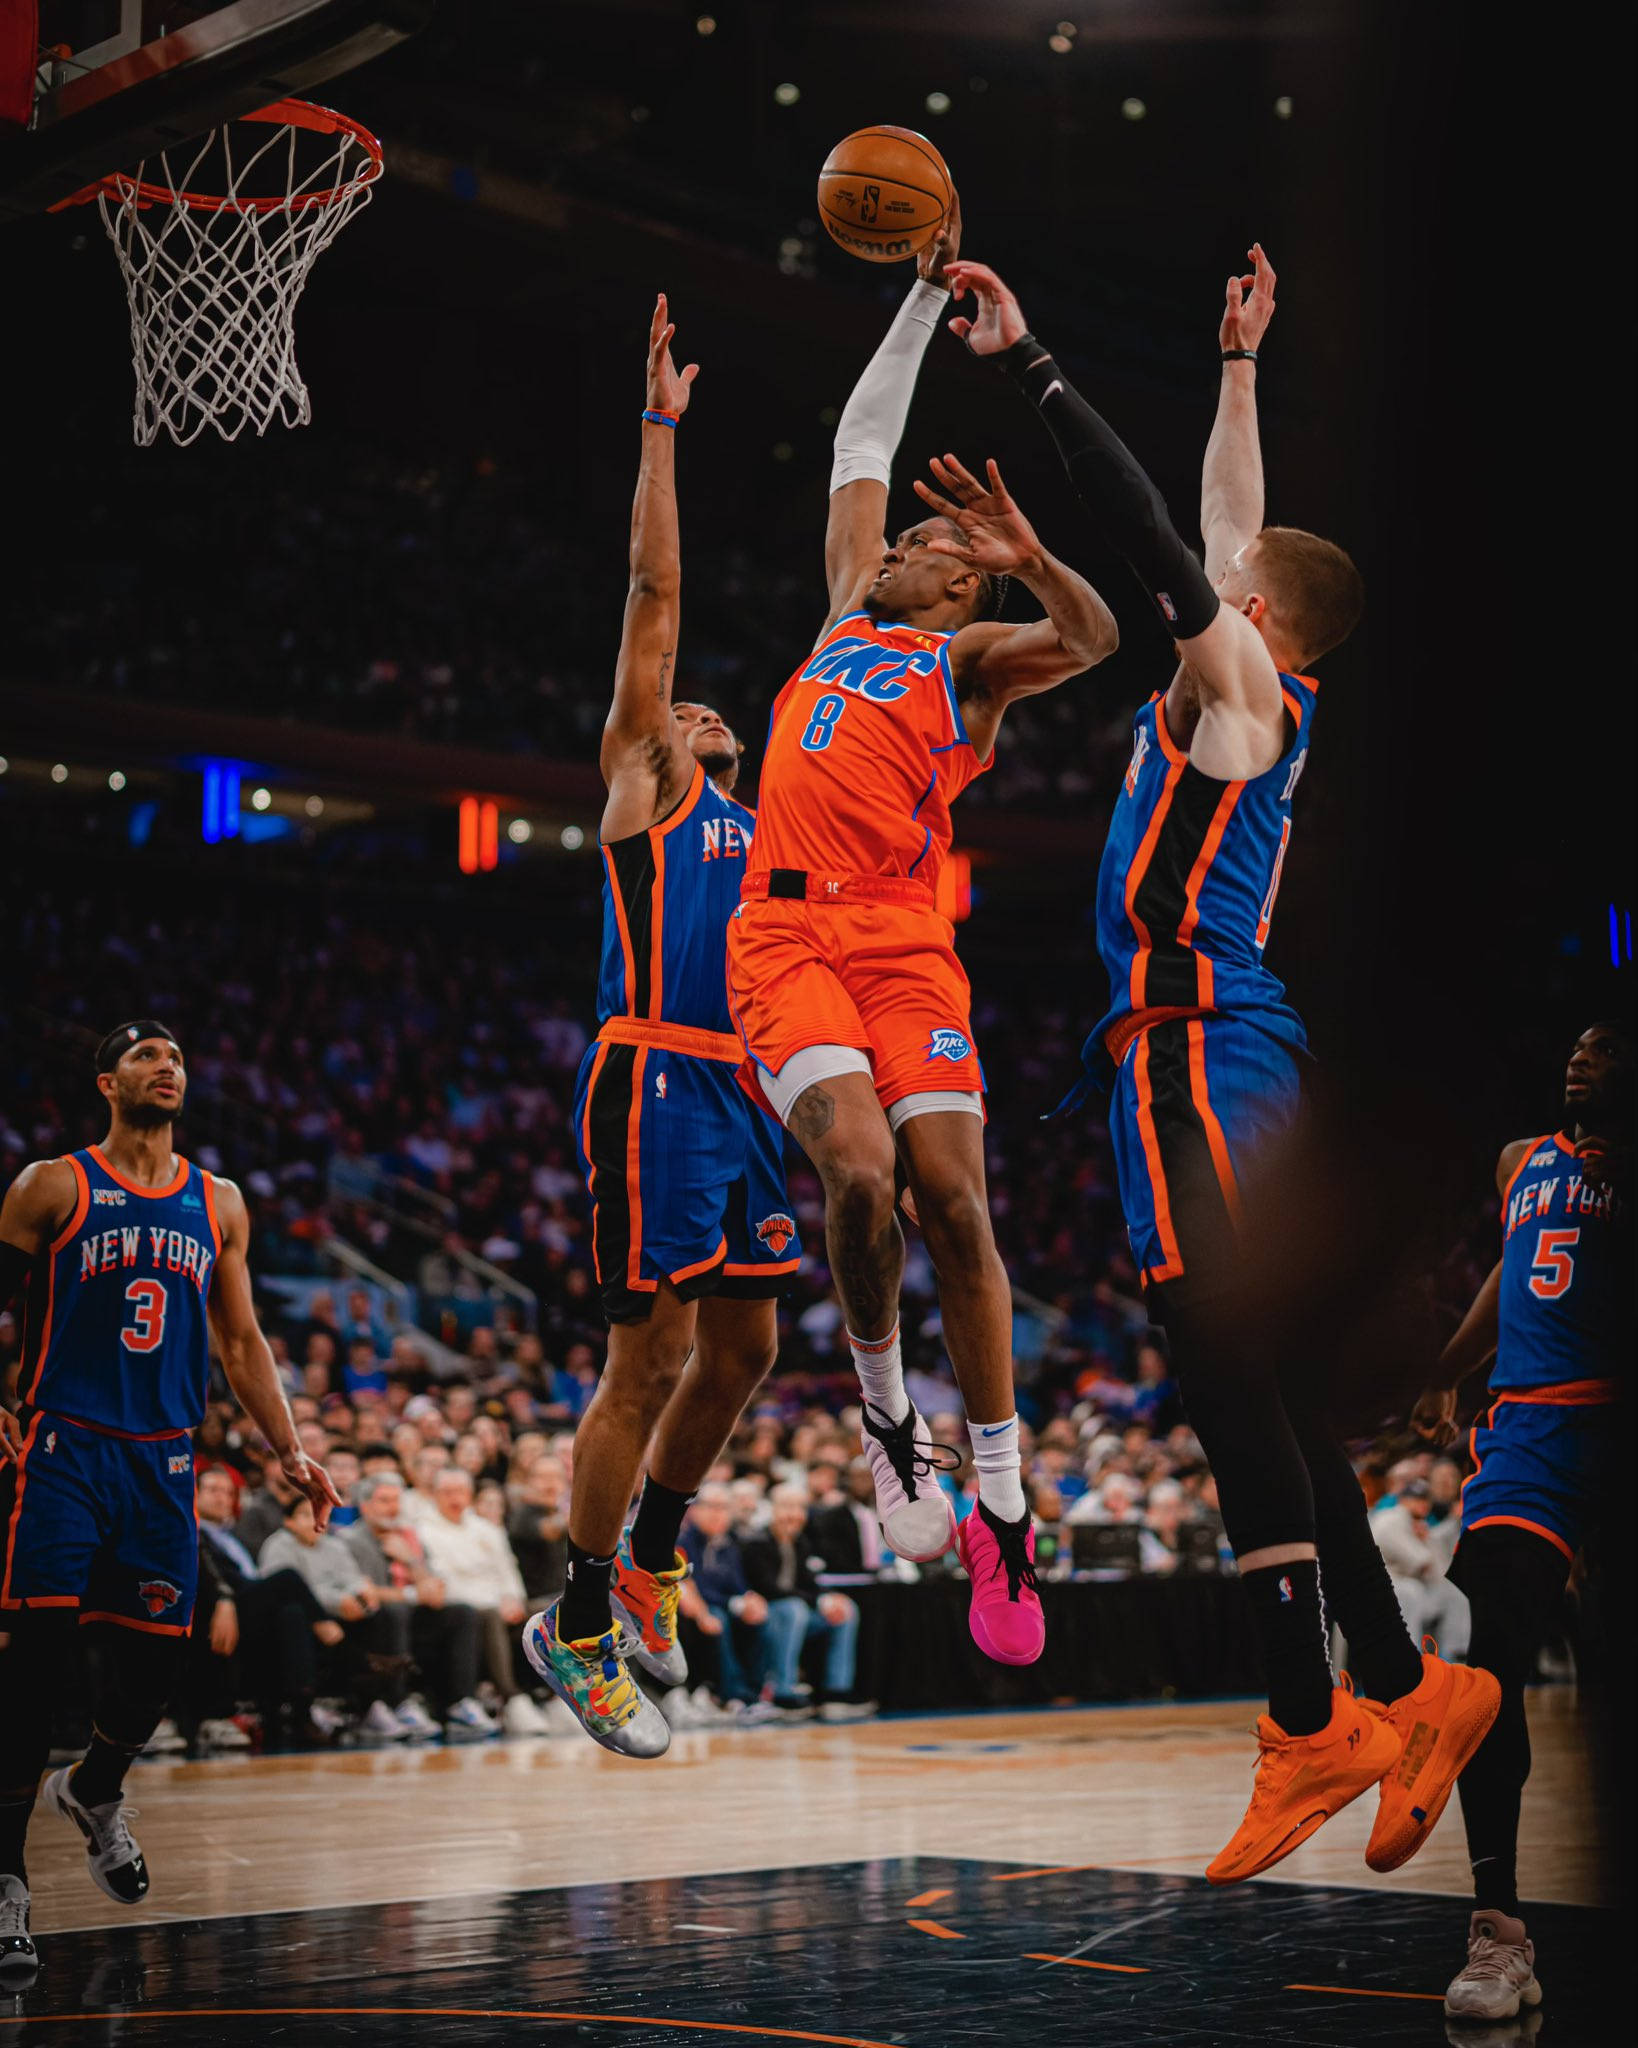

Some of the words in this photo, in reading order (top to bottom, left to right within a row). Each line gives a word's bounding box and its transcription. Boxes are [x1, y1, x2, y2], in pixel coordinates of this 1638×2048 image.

[799, 636, 938, 702] OKC
[801, 694, 846, 751] 8
[1507, 1177, 1560, 1240] NEW
[80, 1226, 141, 1282] NEW
[150, 1227, 212, 1294] YORK
[1528, 1227, 1581, 1300] 5
[120, 1278, 168, 1353] 3
